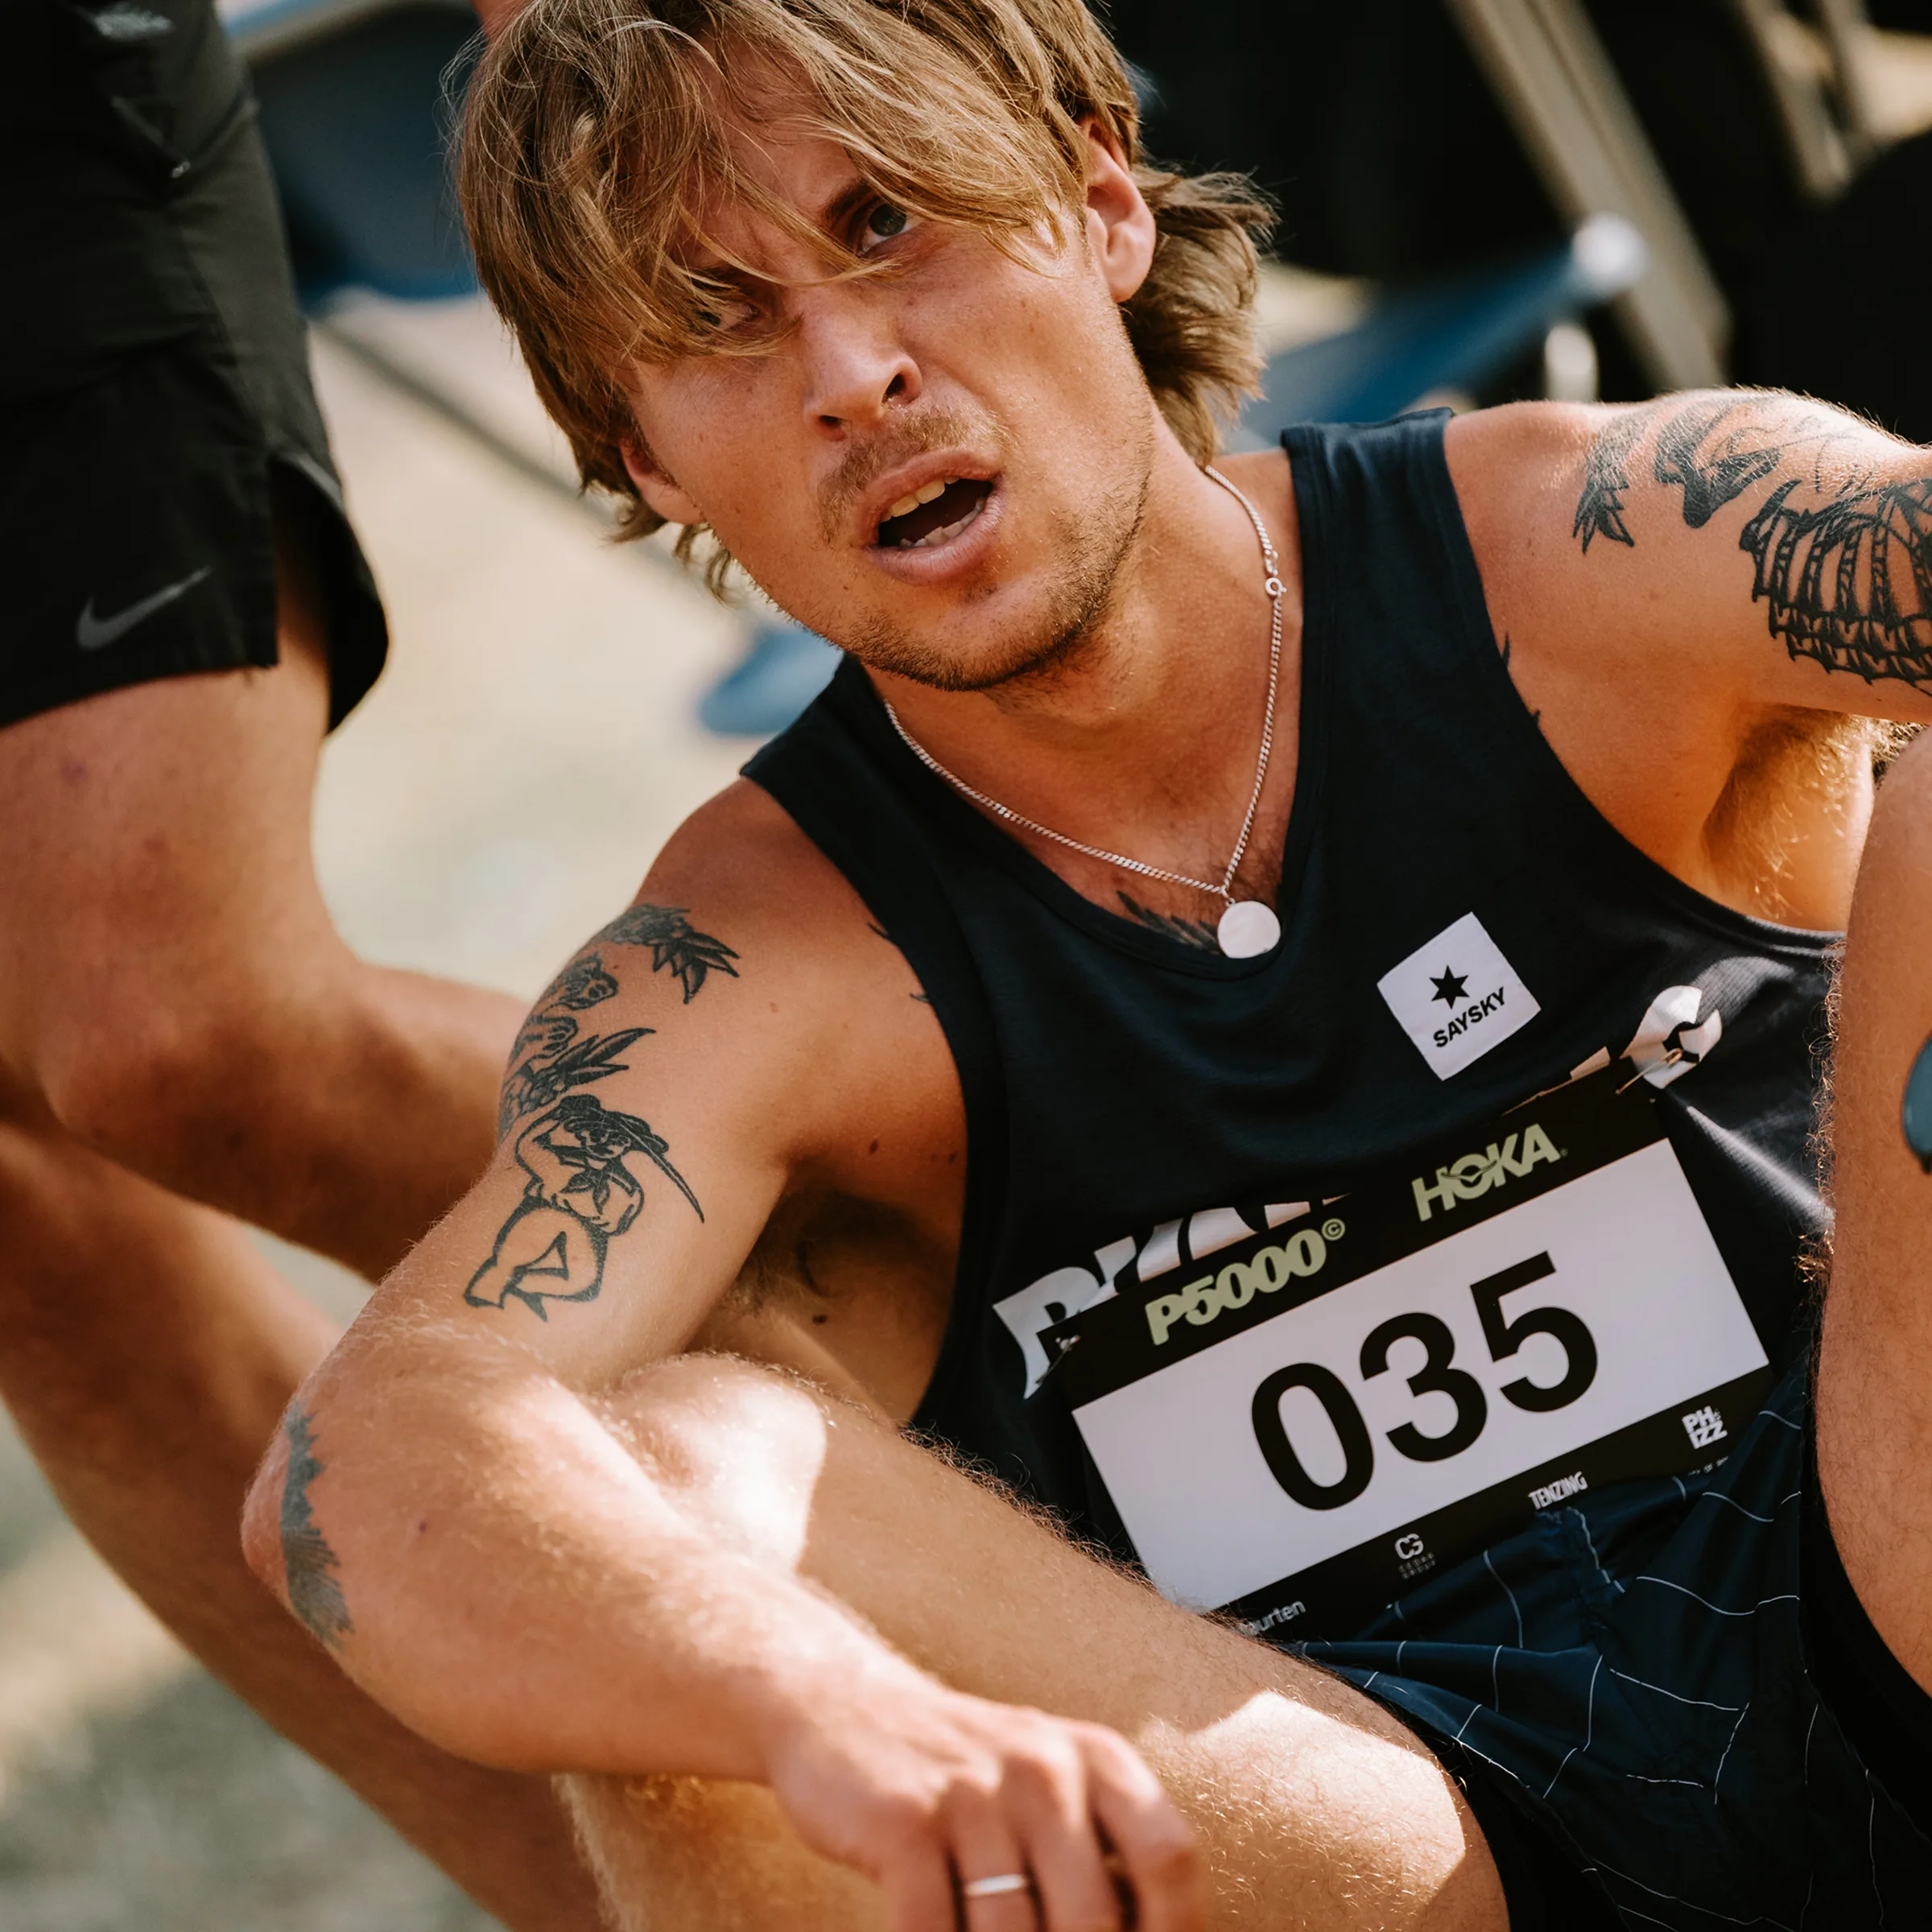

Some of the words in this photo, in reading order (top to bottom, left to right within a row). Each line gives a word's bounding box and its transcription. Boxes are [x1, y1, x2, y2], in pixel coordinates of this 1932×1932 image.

[1433, 987, 1505, 1047] SAYSKY
[1252, 1250, 1598, 1511] 035
[1528, 1471, 1588, 1510] TENZING
